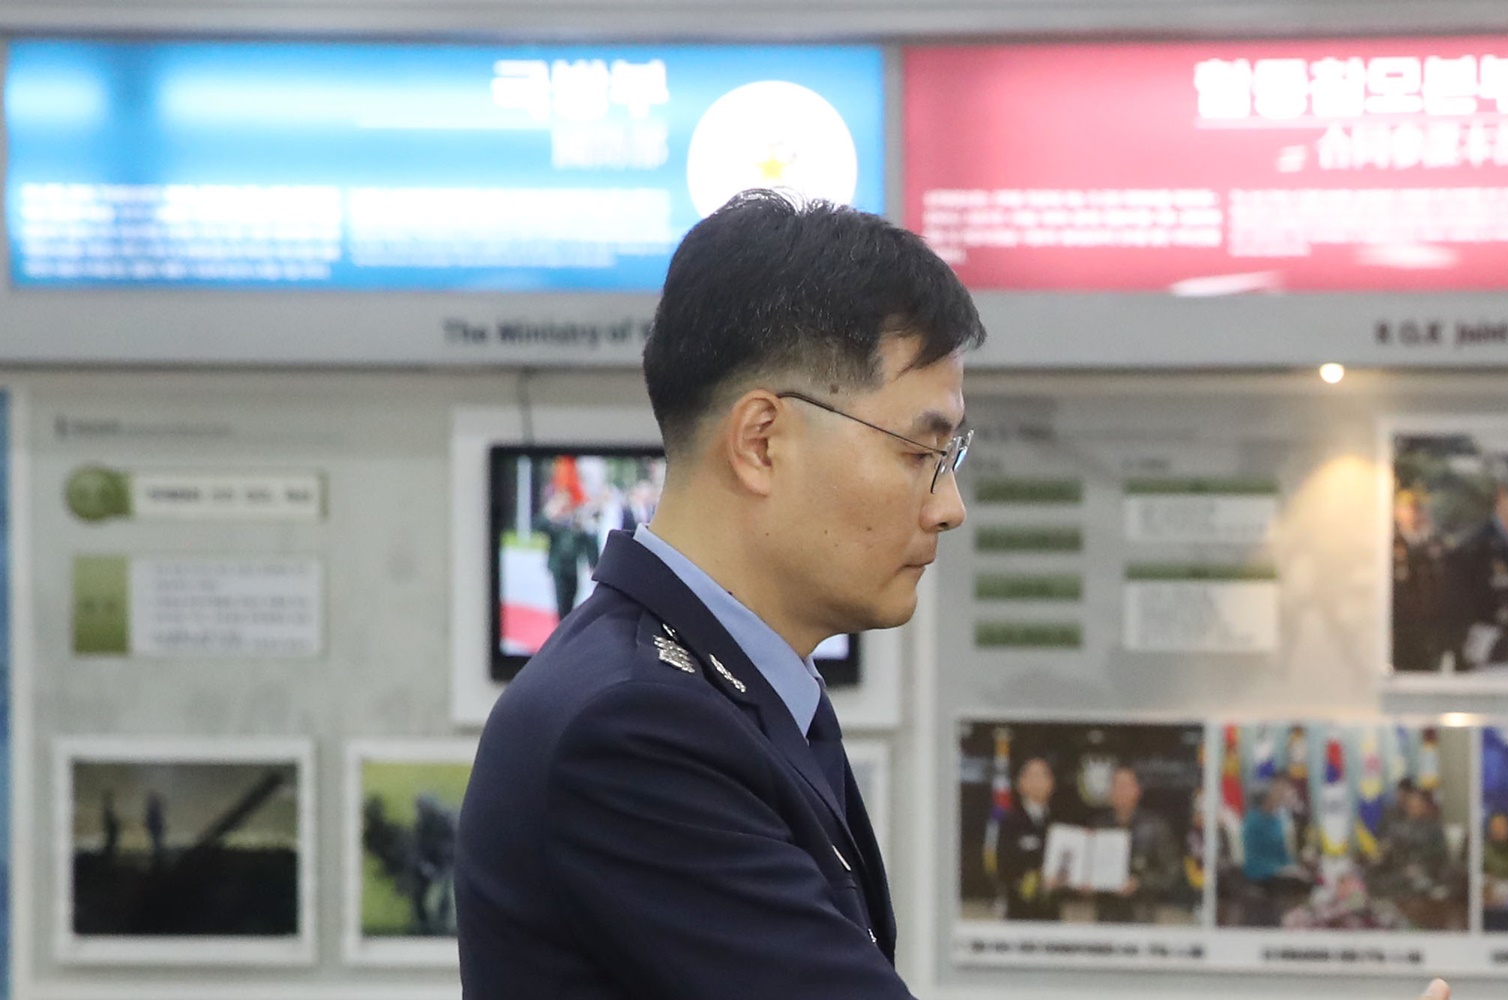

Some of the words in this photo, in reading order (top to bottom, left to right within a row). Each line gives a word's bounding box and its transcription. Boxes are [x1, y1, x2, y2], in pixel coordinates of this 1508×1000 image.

[443, 315, 488, 343] The
[498, 315, 600, 348] Ministry
[608, 314, 634, 343] of
